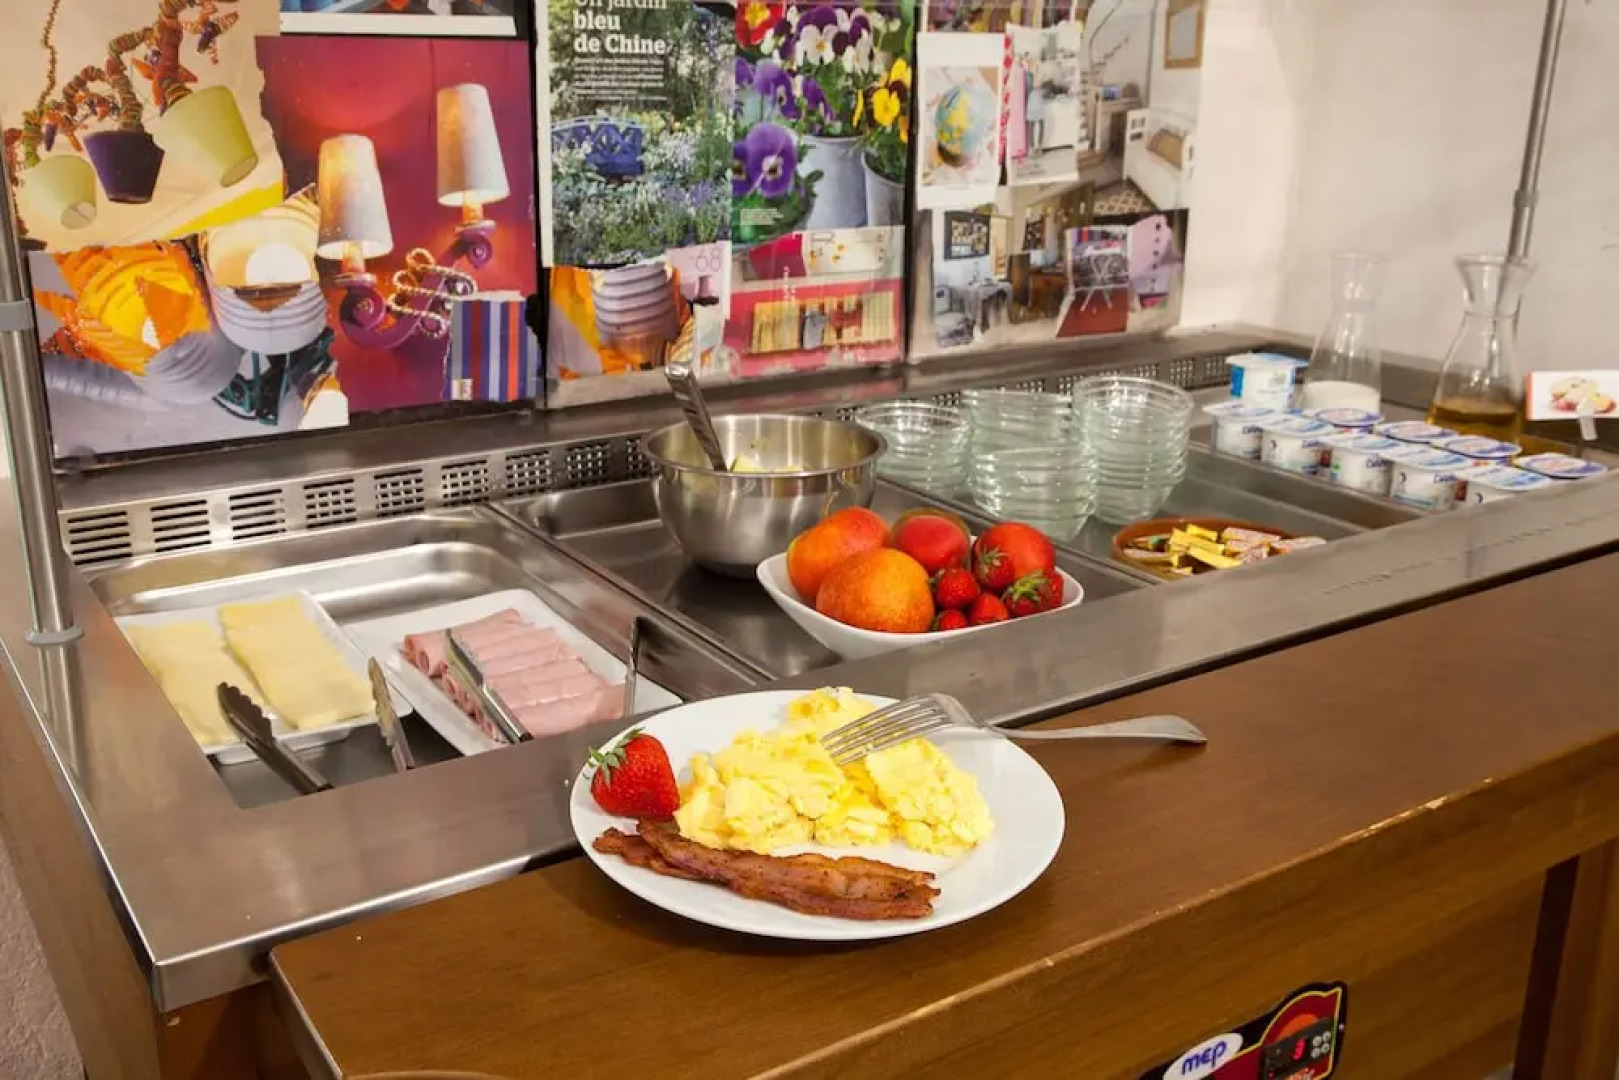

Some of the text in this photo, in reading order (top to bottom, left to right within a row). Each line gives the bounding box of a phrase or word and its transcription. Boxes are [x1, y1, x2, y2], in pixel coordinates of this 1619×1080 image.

[573, 10, 620, 30] bleu
[574, 33, 666, 54] de Chine
